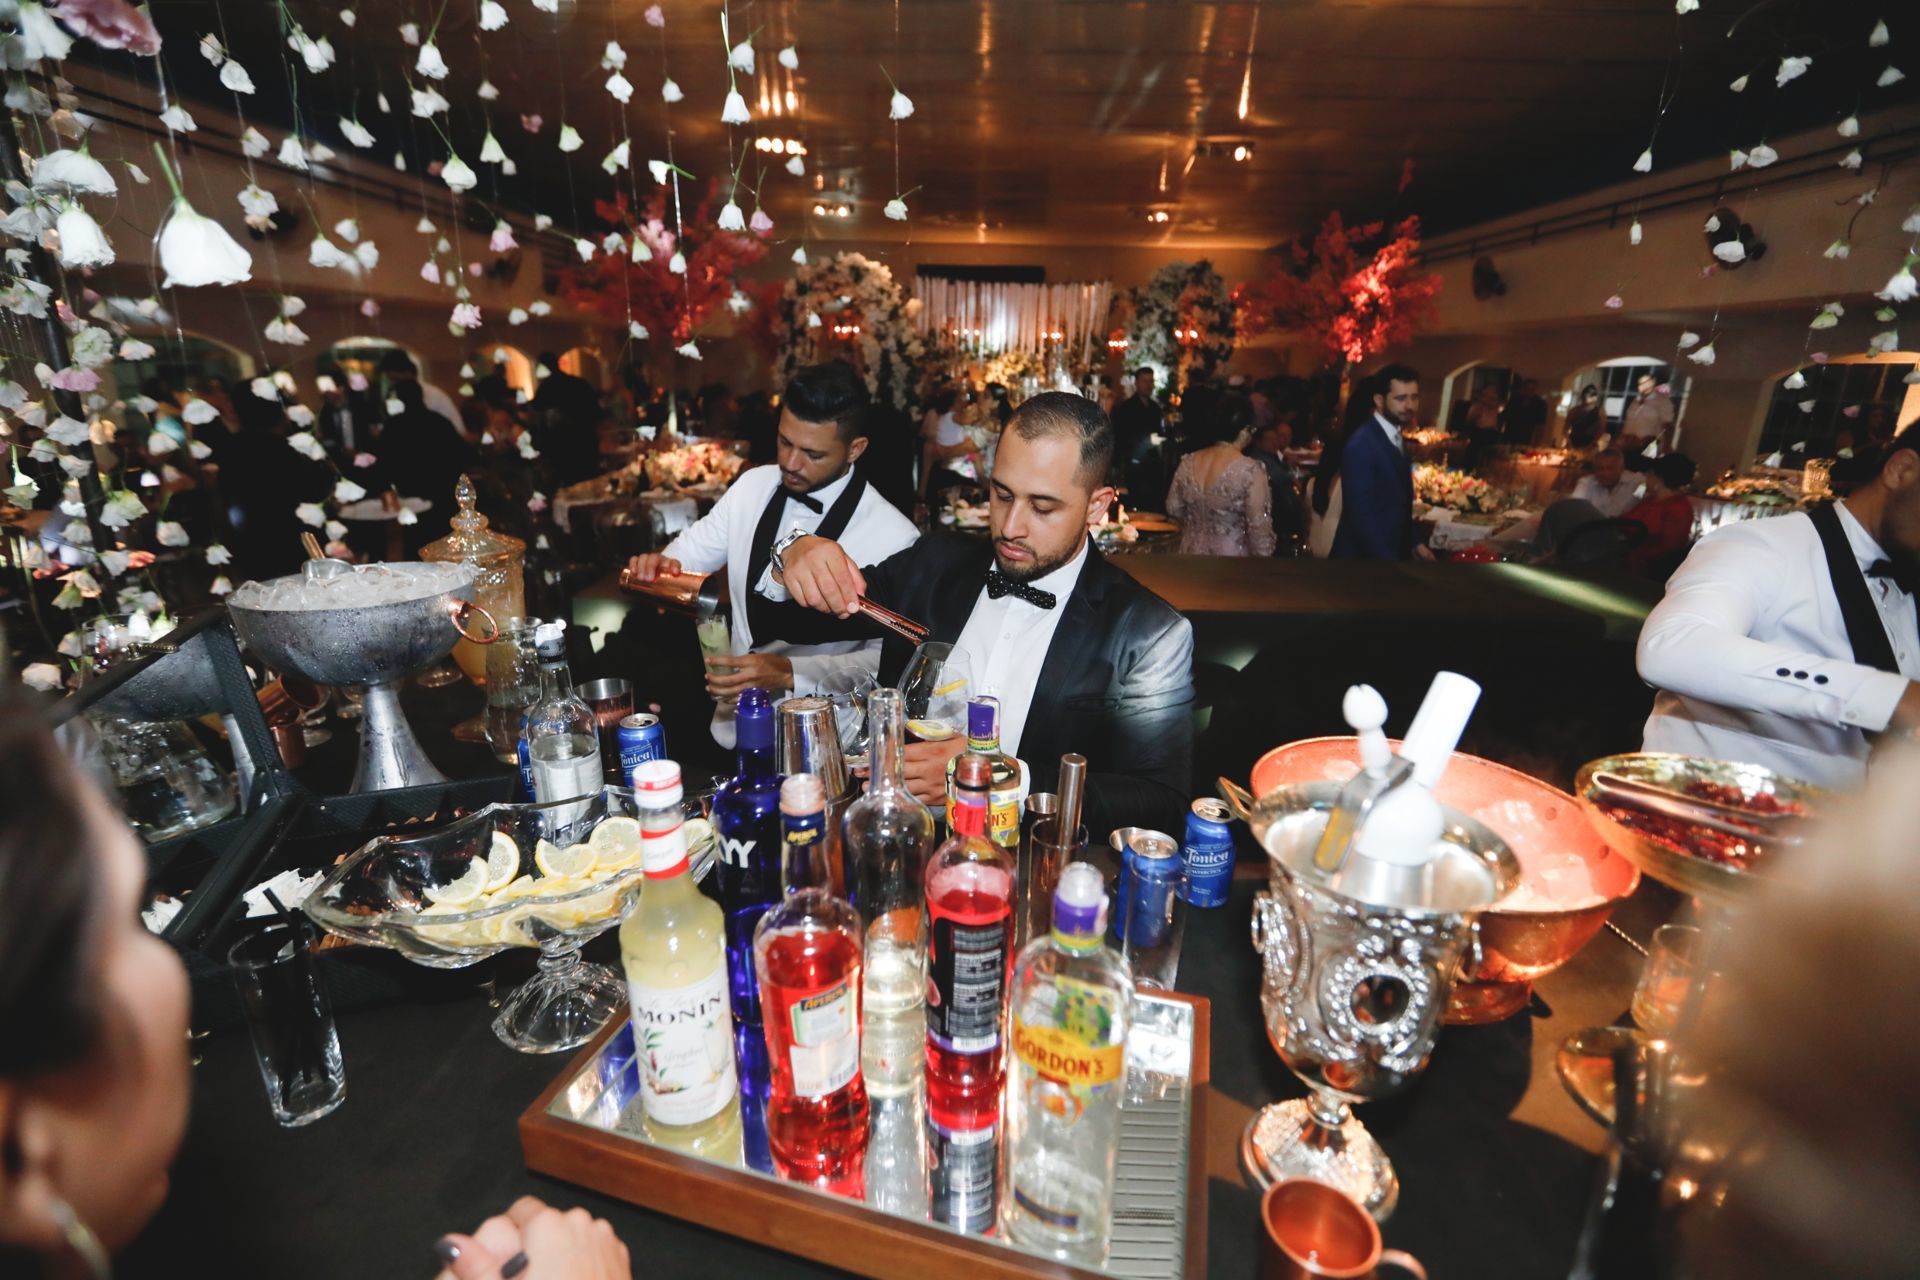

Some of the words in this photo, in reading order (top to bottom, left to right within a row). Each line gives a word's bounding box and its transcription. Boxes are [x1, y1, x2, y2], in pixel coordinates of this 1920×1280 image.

[720, 834, 757, 869] YY
[638, 991, 721, 1024] MONIN
[1014, 1027, 1104, 1077] GORDON'S
